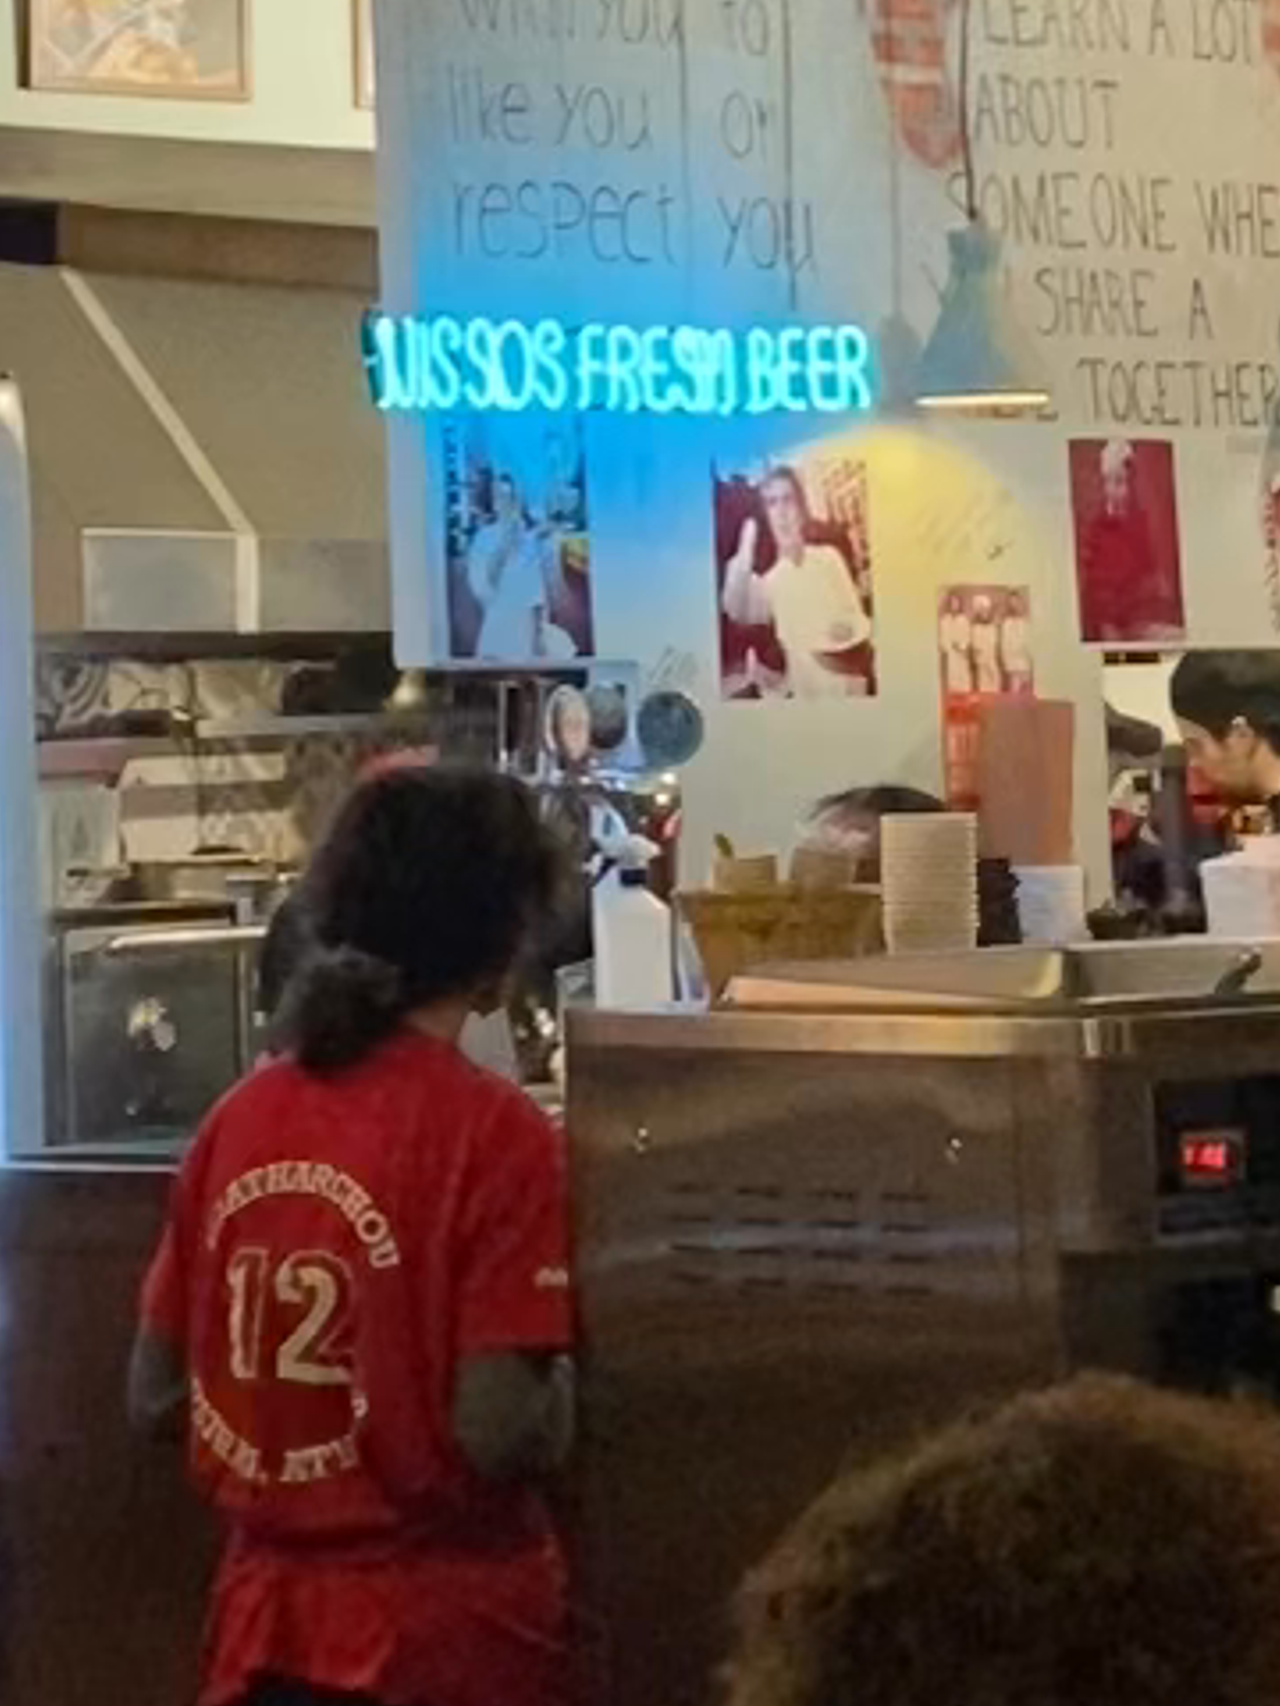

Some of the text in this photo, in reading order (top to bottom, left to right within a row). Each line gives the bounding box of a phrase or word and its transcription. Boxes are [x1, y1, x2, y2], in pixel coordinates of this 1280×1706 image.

[971, 77, 1121, 151] ABOUT
[1035, 266, 1160, 340] SHARE
[1188, 278, 1216, 341] A
[745, 322, 873, 414] BEER
[226, 1245, 360, 1385] 12
